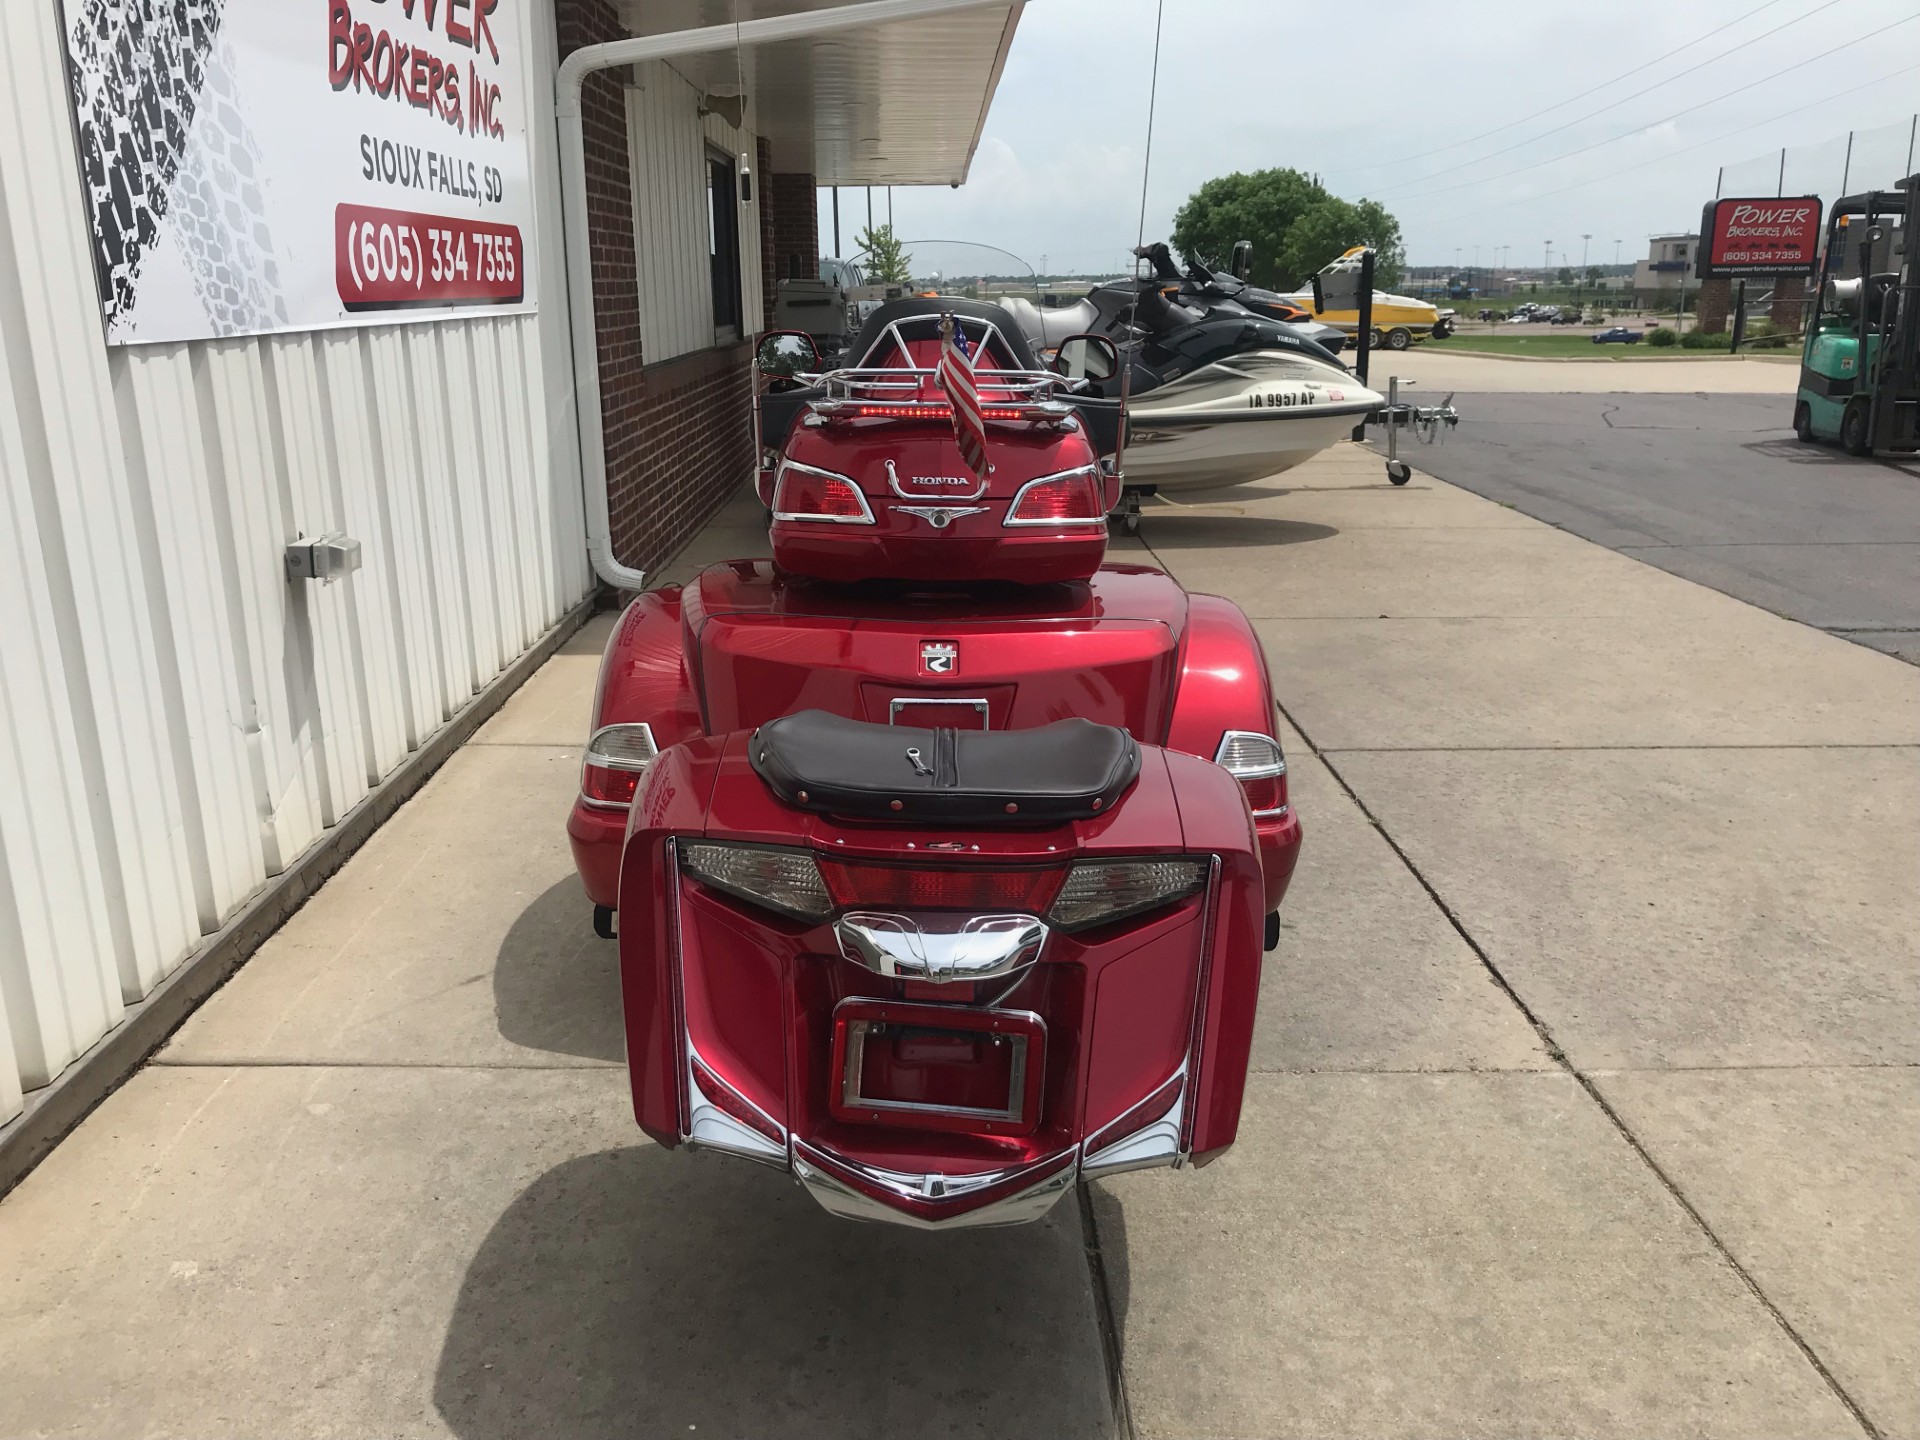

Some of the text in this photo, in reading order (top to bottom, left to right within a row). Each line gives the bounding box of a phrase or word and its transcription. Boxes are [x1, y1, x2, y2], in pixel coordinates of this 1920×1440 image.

[328, 0, 504, 142] BROKERS, INC.
[360, 133, 502, 207] SIOUX FALLS, SD
[1729, 205, 1810, 226] POWER
[1726, 225, 1803, 238] BROKERS, INC.
[348, 220, 515, 292] (605) 334 7355
[1723, 251, 1801, 262] (605) 334 7355
[1712, 265, 1810, 273] www.powerbrokersinc.com
[1277, 335, 1300, 345] YAMAHA
[1249, 394, 1262, 408] IA
[1268, 393, 1296, 407] 9957
[1301, 392, 1315, 405] AP
[911, 476, 970, 485] HONDA
